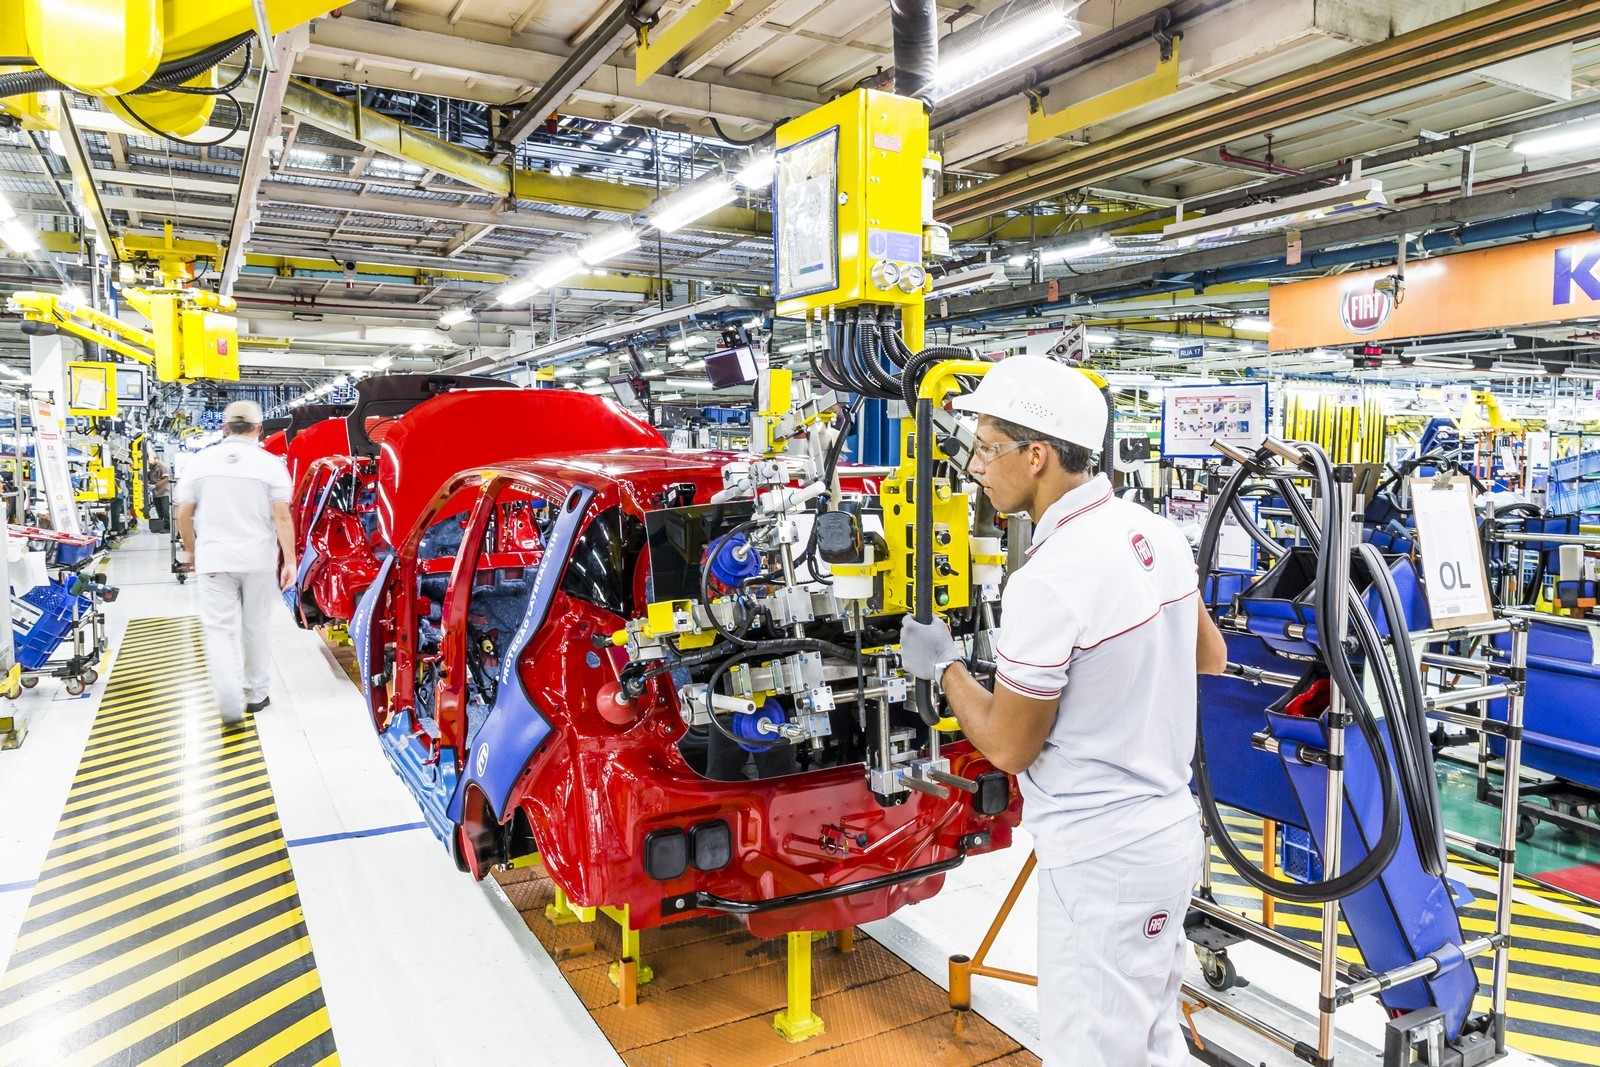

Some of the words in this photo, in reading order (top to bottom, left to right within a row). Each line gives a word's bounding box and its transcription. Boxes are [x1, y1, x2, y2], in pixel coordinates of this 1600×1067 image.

[1351, 292, 1381, 321] FIAT
[96, 317, 128, 337] dalmec
[1180, 349, 1193, 357] RUA
[1134, 538, 1152, 562] FIAT
[1439, 561, 1471, 590] OL
[502, 619, 530, 685] PROTEÇÃO
[527, 560, 548, 617] LATERAL
[1149, 917, 1166, 932] FIAT
